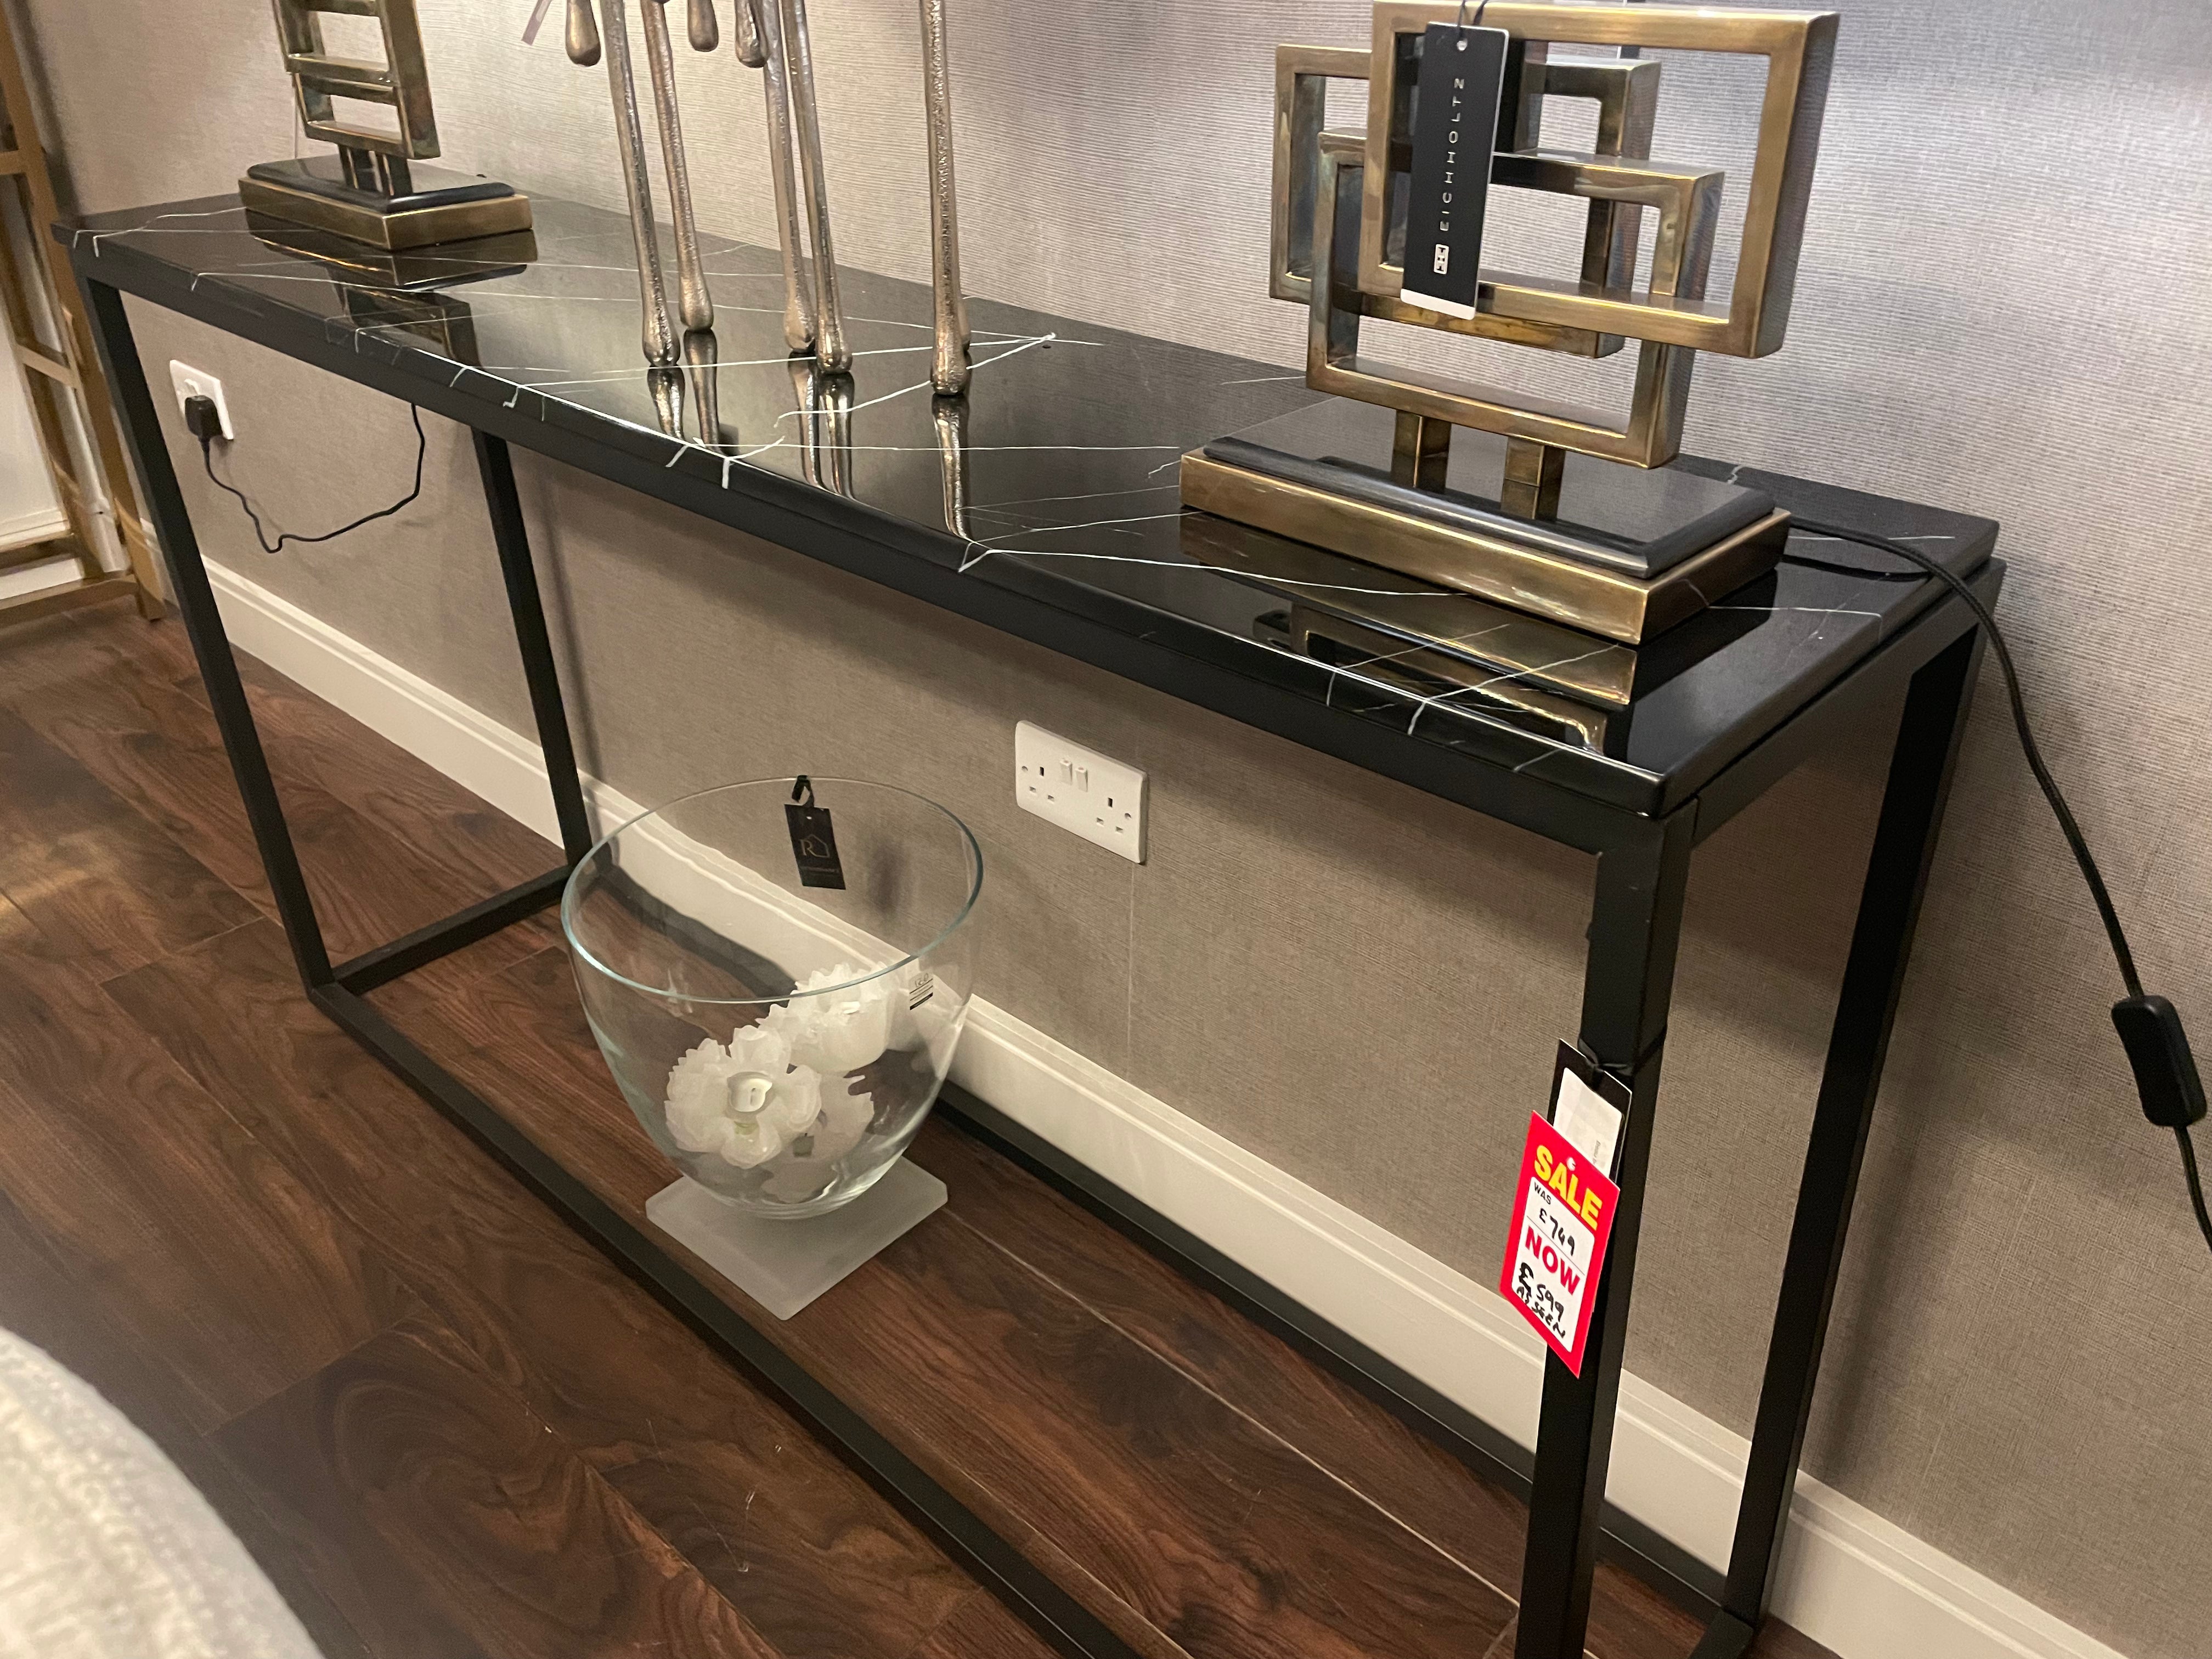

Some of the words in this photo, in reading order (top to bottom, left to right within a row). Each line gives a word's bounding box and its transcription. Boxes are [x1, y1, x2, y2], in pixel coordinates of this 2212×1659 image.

[1440, 78, 1465, 232] EICHHOLTZ
[1534, 1144, 1603, 1231] SALE
[1534, 1181, 1552, 1205] WAS
[1518, 1262, 1565, 1323] £599
[1525, 1224, 1581, 1296] NOW
